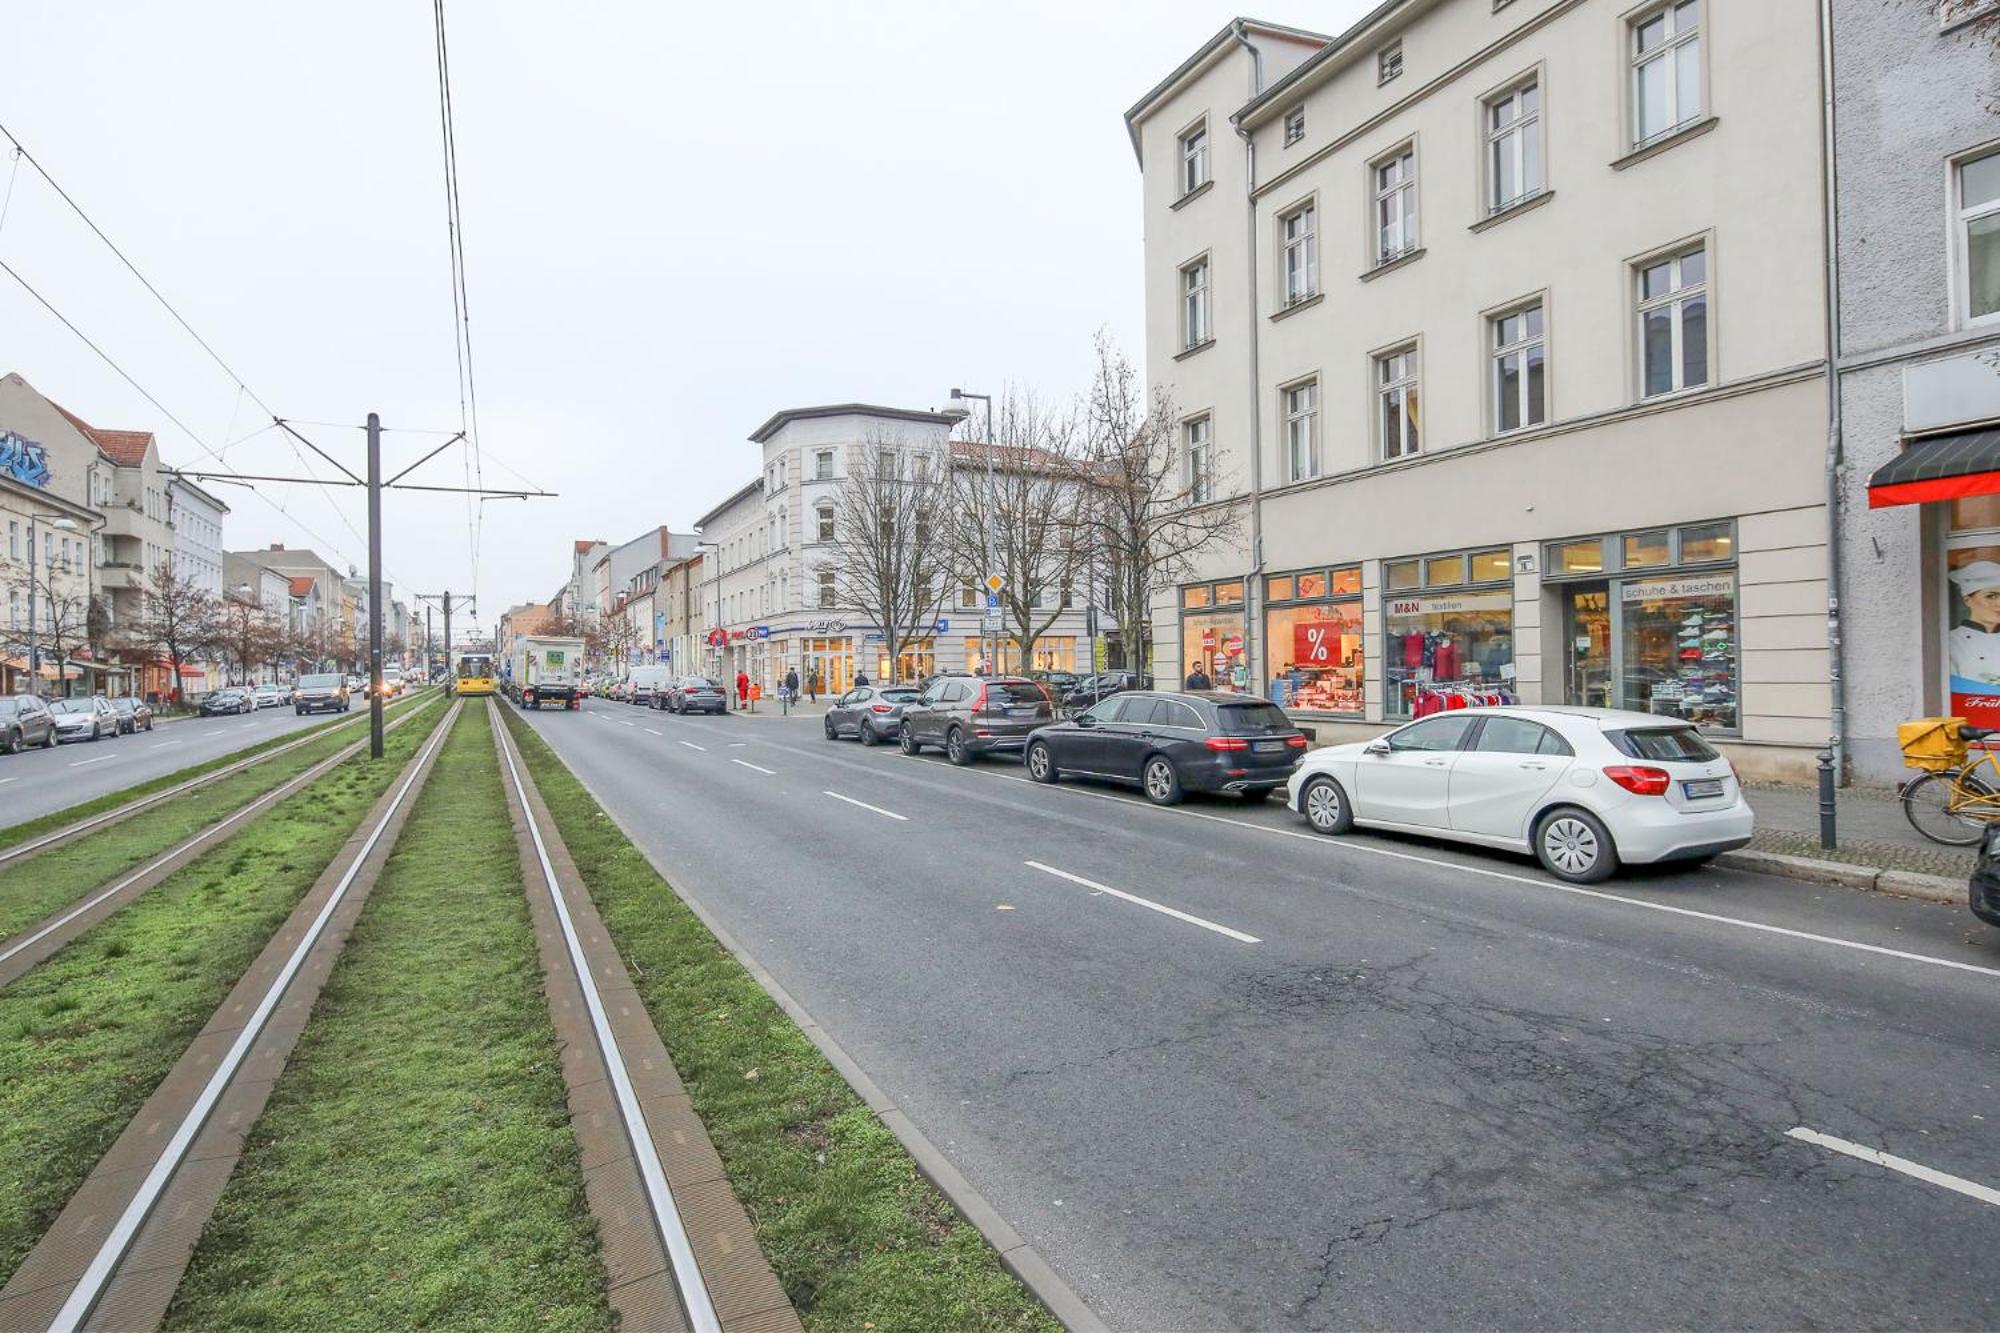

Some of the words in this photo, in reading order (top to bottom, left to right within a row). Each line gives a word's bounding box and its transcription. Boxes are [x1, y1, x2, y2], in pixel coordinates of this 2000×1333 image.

[1626, 587, 1666, 598] schuhe
[1670, 584, 1678, 594] &
[1681, 581, 1730, 593] taschen
[1394, 602, 1420, 614] M&N
[1307, 628, 1328, 660] %
